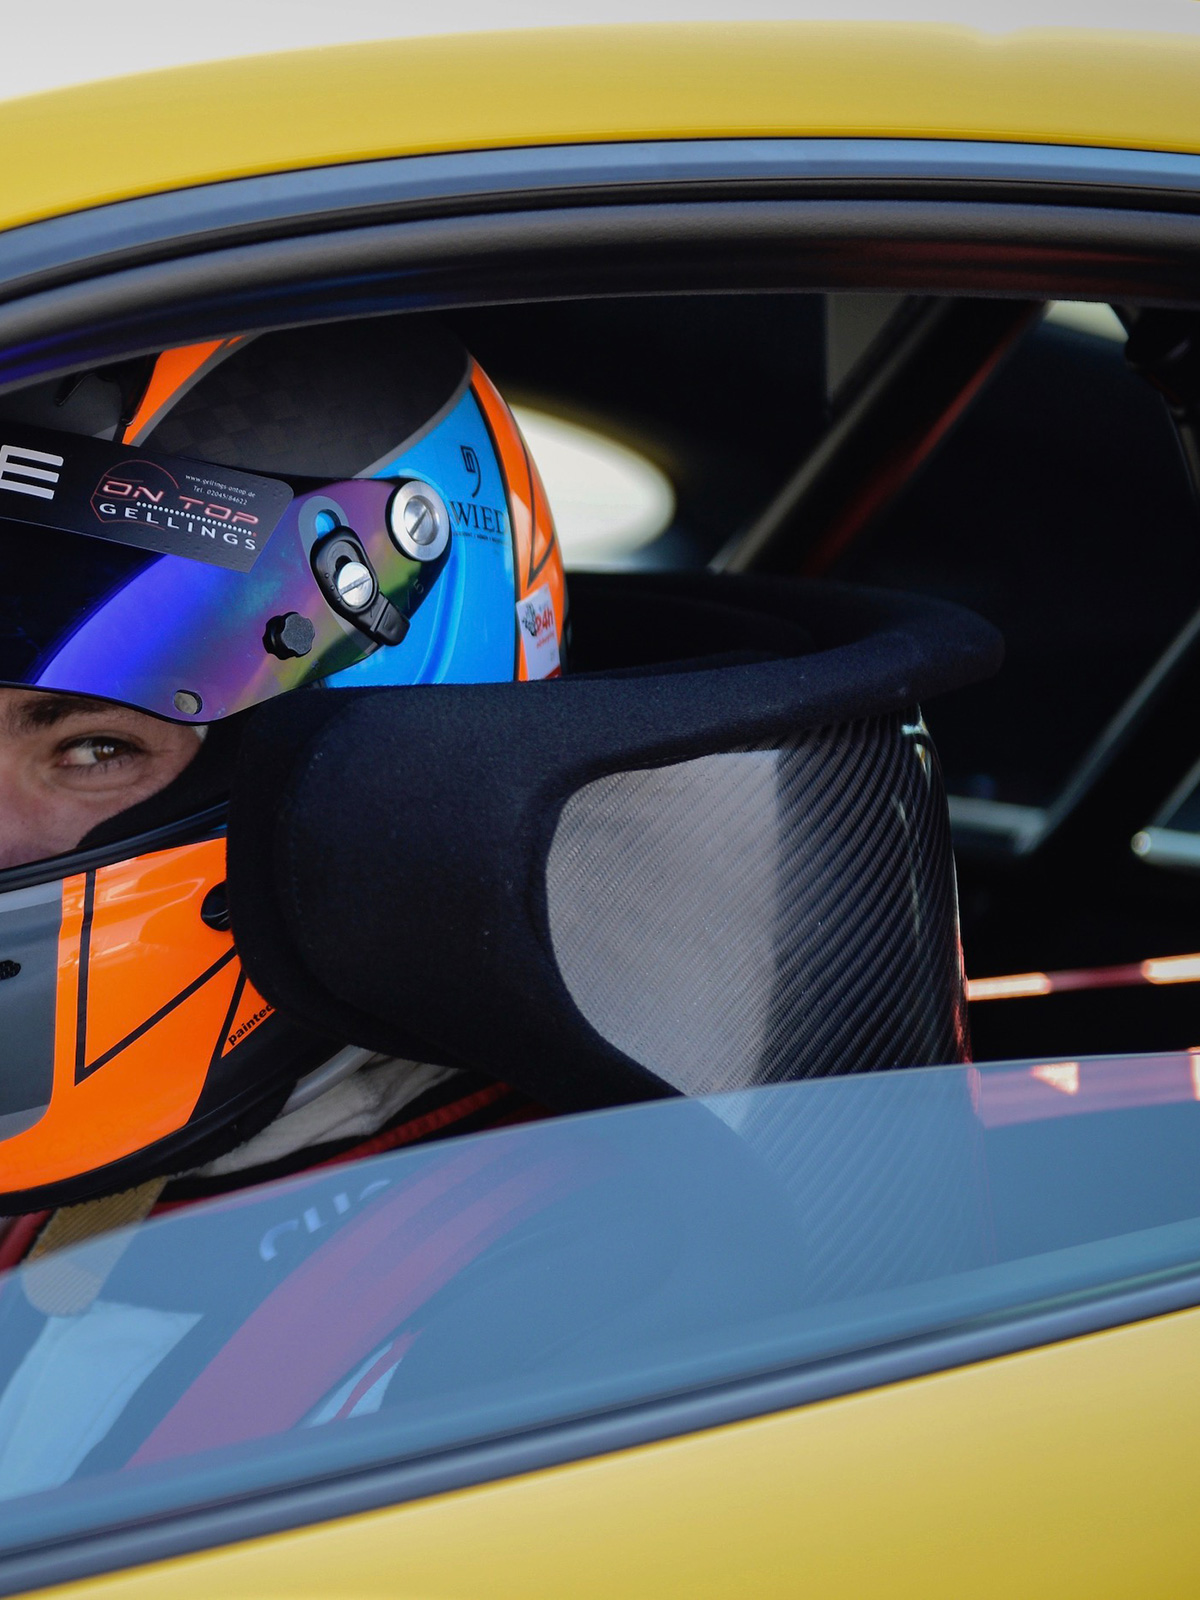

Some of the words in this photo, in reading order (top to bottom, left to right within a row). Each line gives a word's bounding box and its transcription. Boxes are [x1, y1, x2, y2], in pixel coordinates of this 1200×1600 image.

[102, 480, 165, 503] ON
[179, 495, 259, 525] TOP
[193, 485, 205, 494] Tel.
[99, 503, 256, 551] GELLINGS
